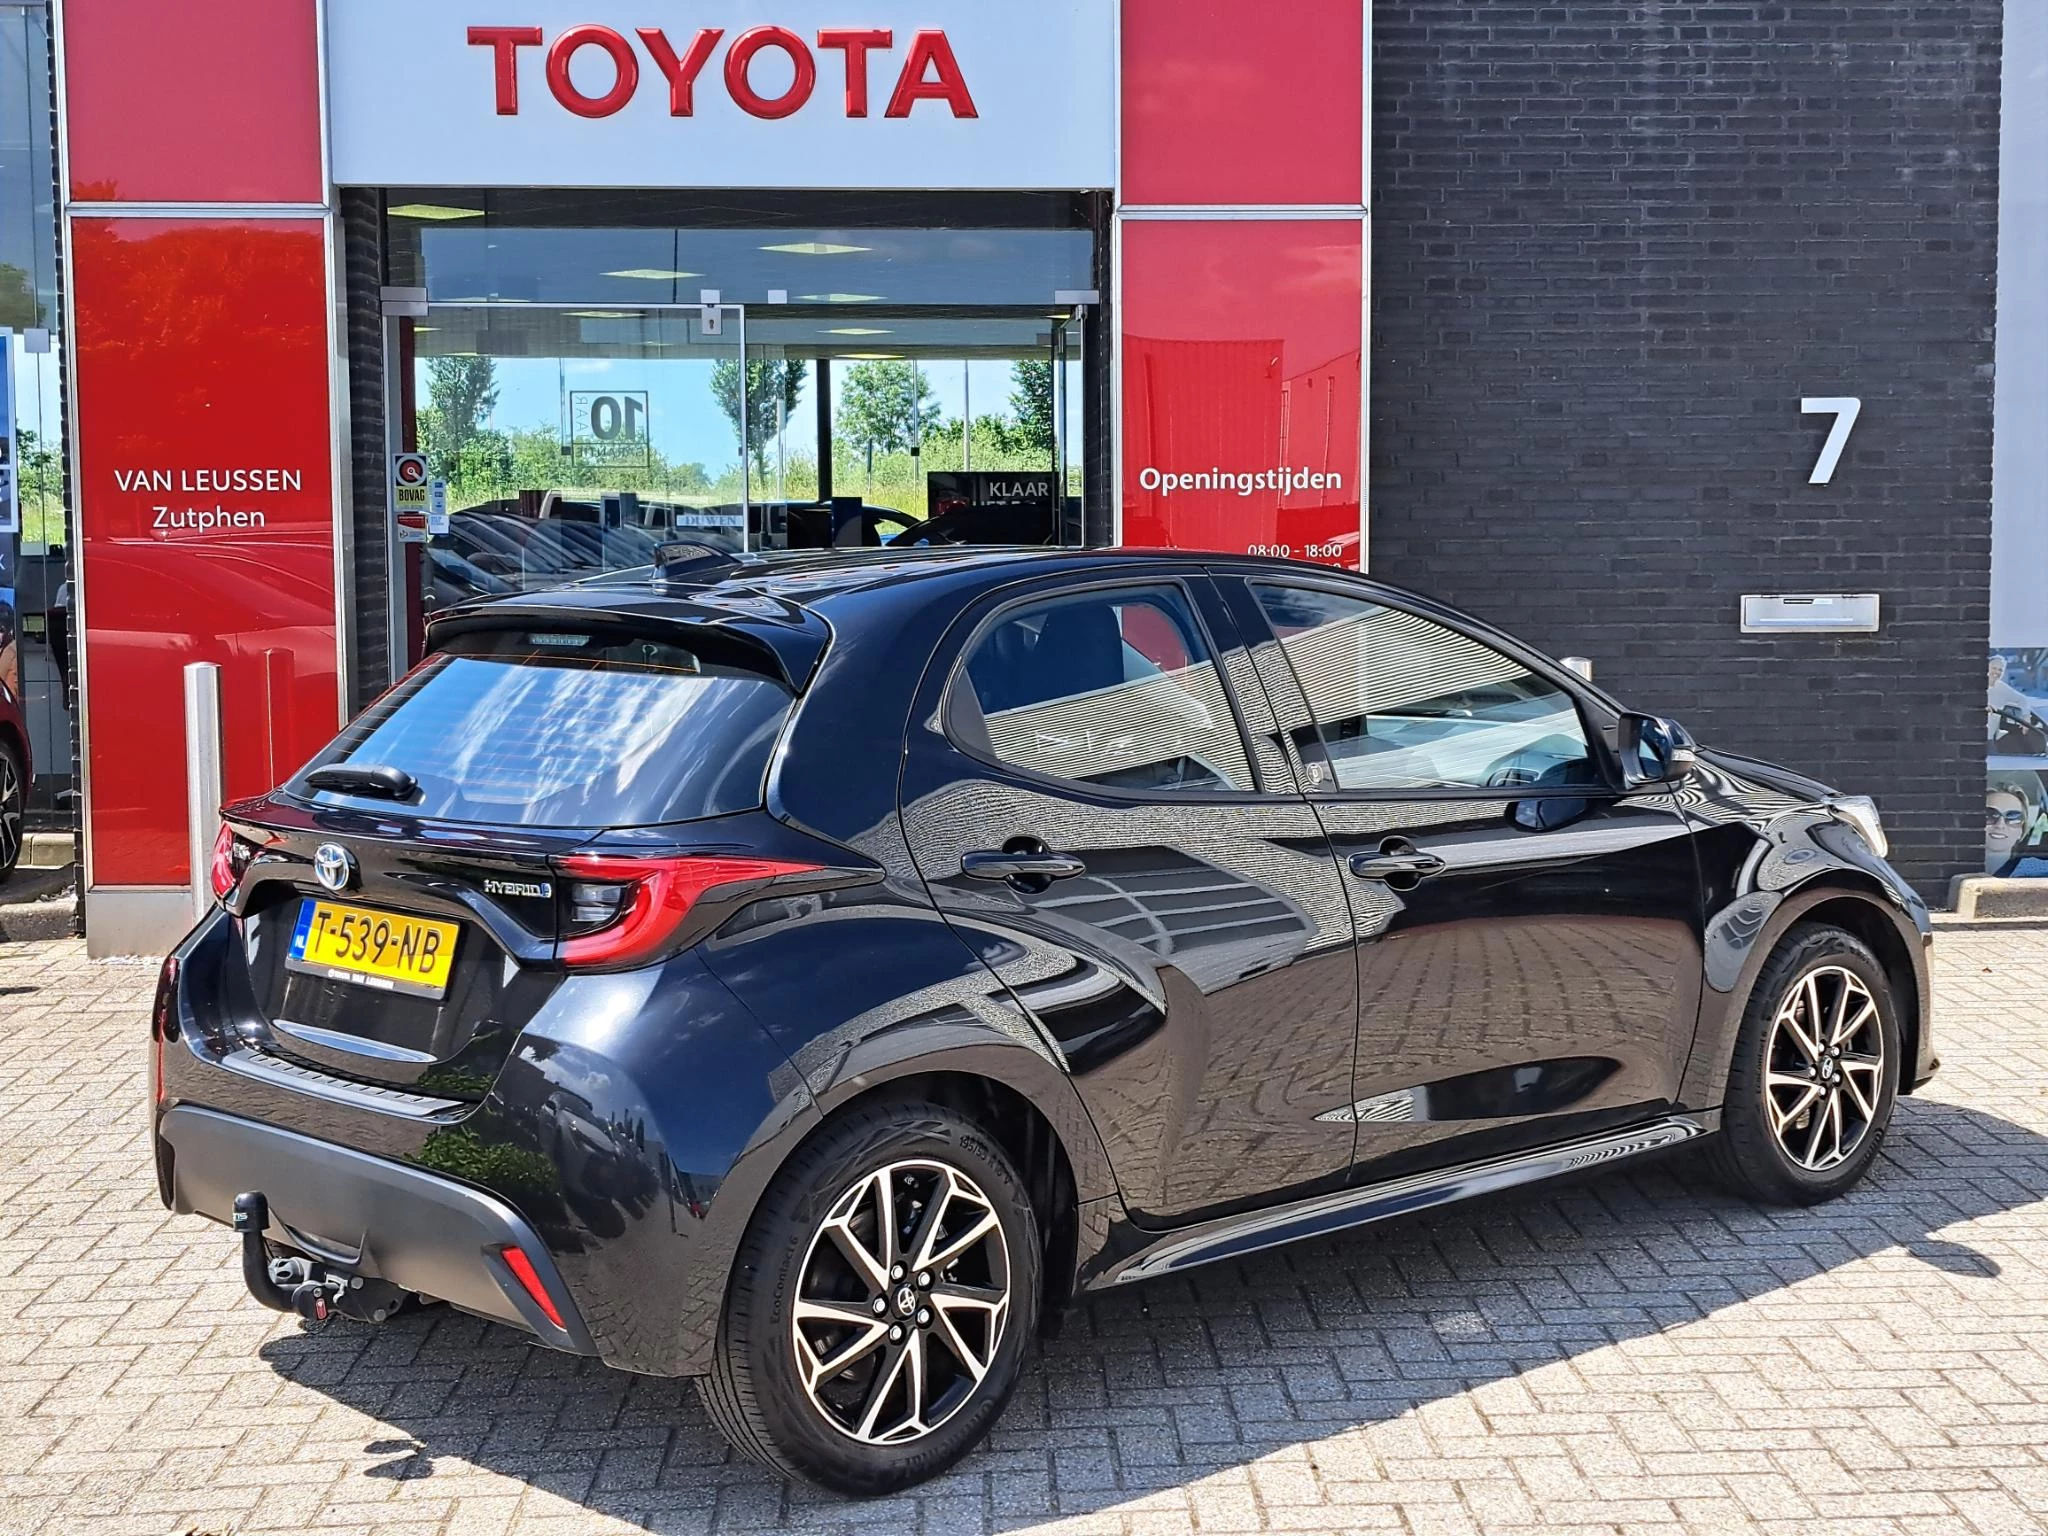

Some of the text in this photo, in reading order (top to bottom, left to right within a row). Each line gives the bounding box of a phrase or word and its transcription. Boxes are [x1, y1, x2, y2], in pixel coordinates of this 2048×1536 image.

[467, 24, 979, 120] TOYOTA
[1801, 397, 1861, 484] 7
[114, 469, 302, 492] VAN LEUSSEN
[989, 482, 1049, 497] KLAAR
[1139, 467, 1342, 497] Openingstijden
[398, 489, 425, 501] BOVAG
[152, 505, 266, 533] Zutphen
[1247, 544, 1290, 558] 08:00
[1304, 544, 1342, 558] 18:00
[484, 879, 541, 897] HYBRID
[314, 911, 441, 973] T-539-NB
